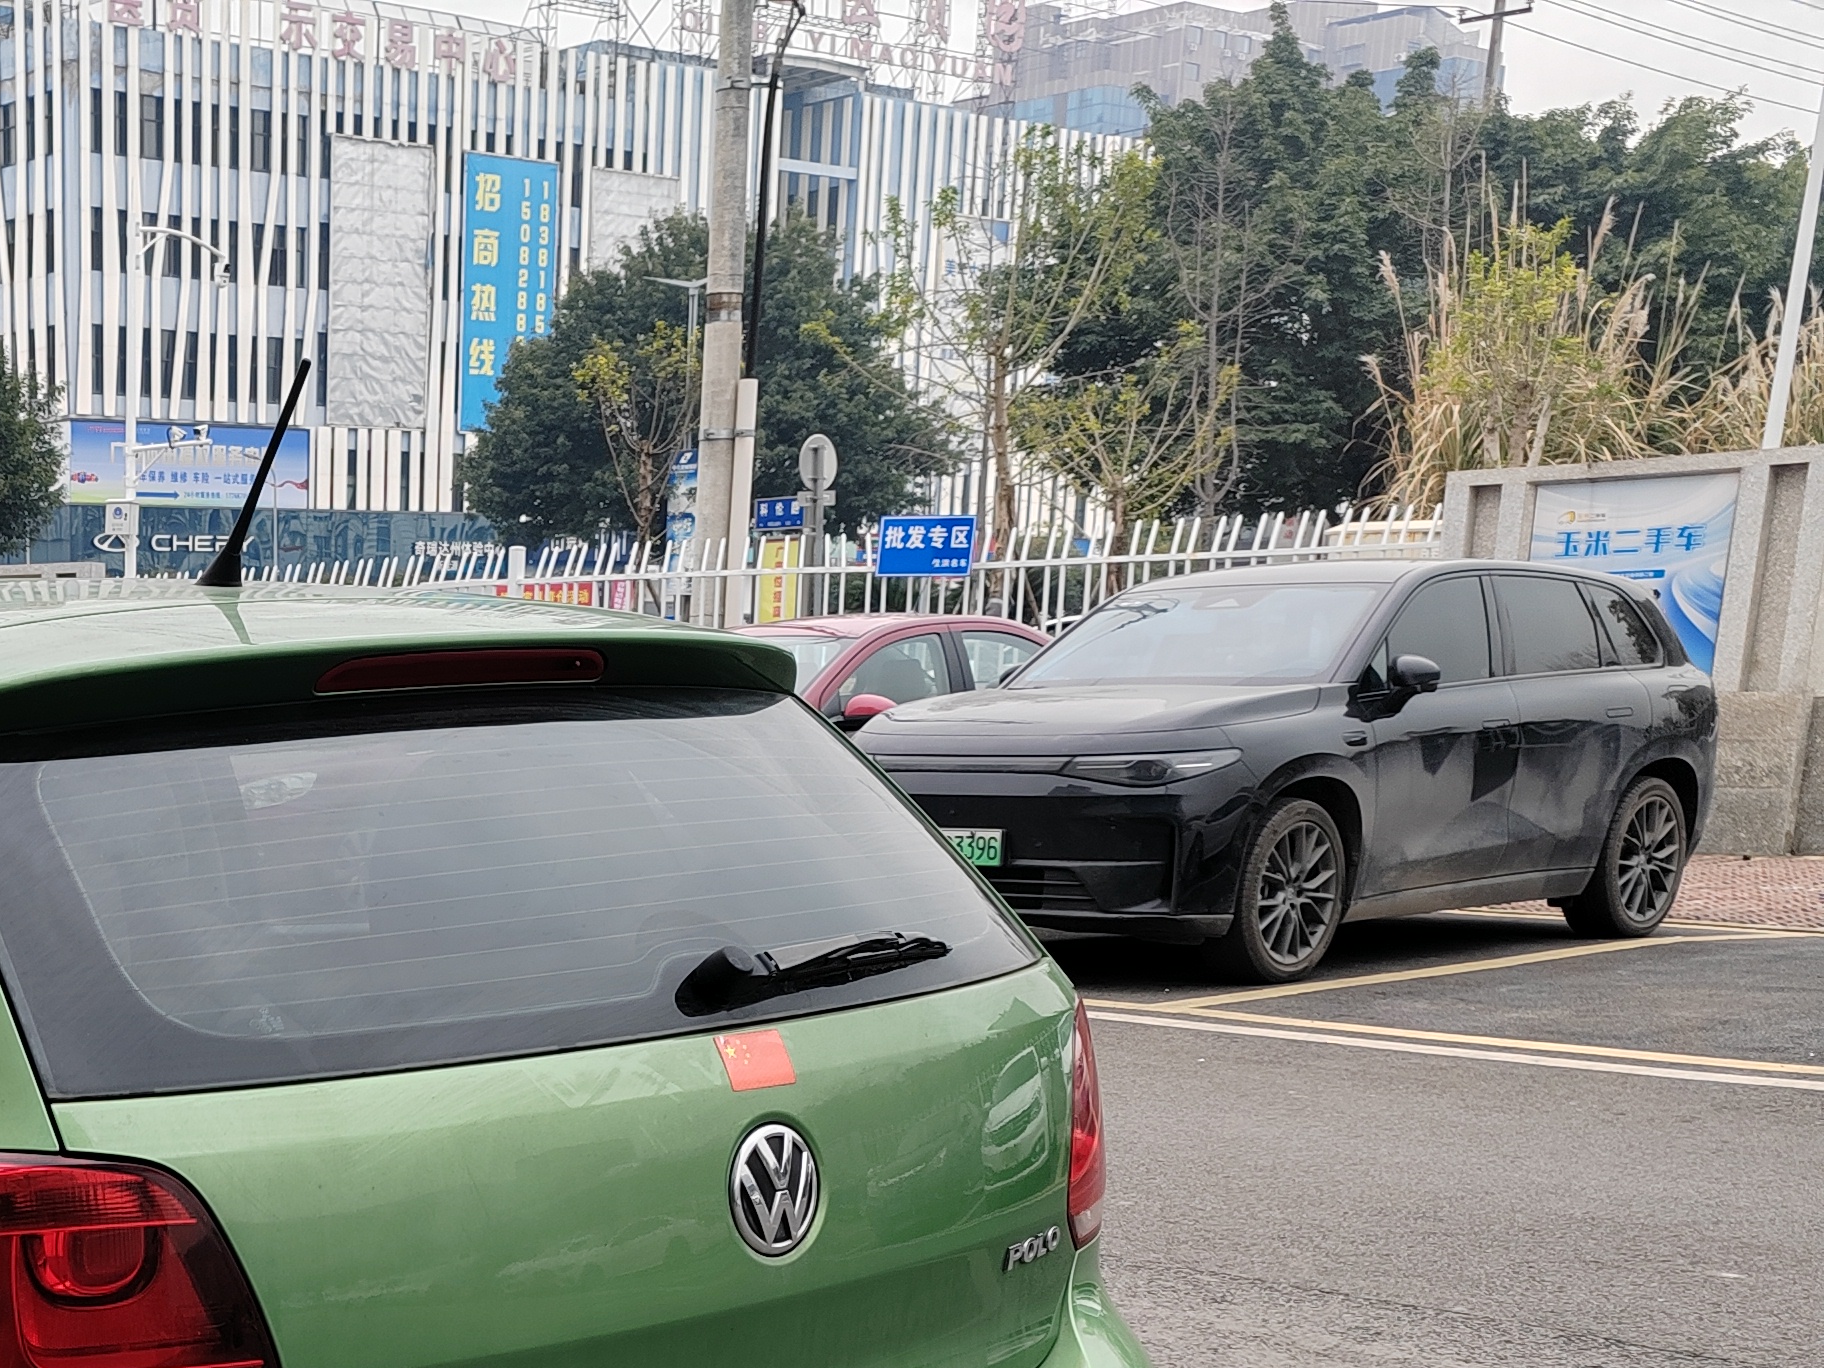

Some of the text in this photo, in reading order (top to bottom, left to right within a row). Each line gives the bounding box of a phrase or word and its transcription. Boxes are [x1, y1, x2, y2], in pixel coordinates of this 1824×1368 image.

[468, 171, 502, 377] 招商热线
[884, 525, 970, 549] 批发专区
[1554, 524, 1707, 557] 玉米二手车
[946, 834, 999, 861] 3396
[1003, 1225, 1061, 1272] POLO
